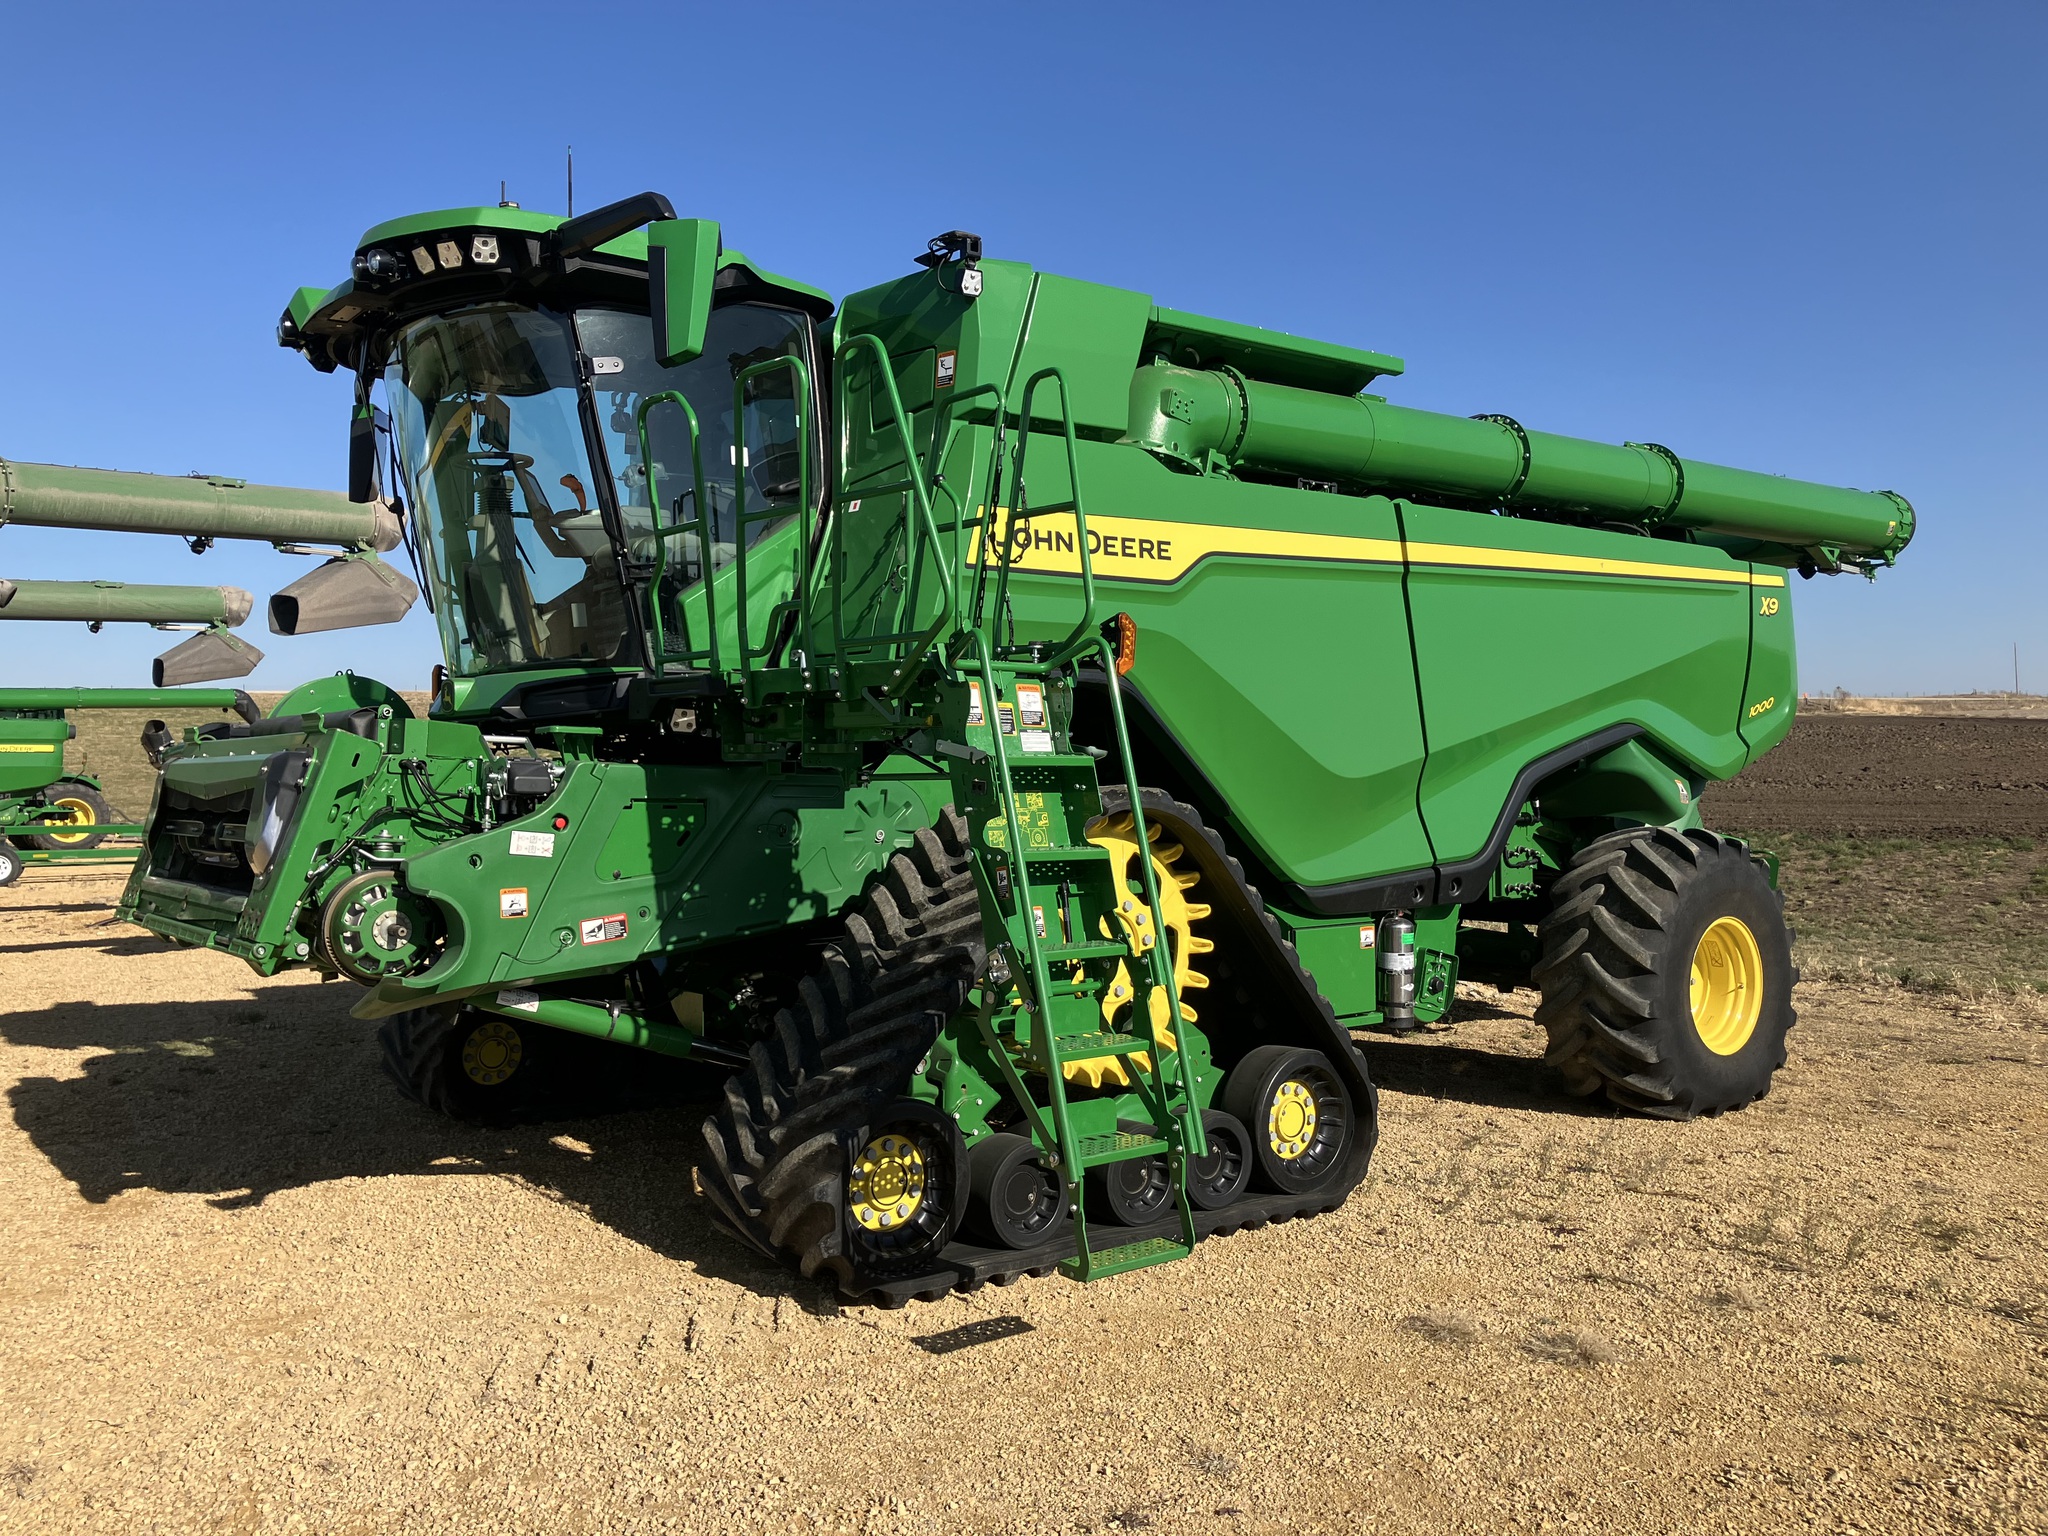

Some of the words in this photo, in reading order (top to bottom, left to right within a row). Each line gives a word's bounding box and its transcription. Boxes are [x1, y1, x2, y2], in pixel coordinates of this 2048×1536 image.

[1086, 529, 1172, 561] DEERE
[1759, 596, 1779, 617] X9
[1748, 696, 1775, 718] 1000
